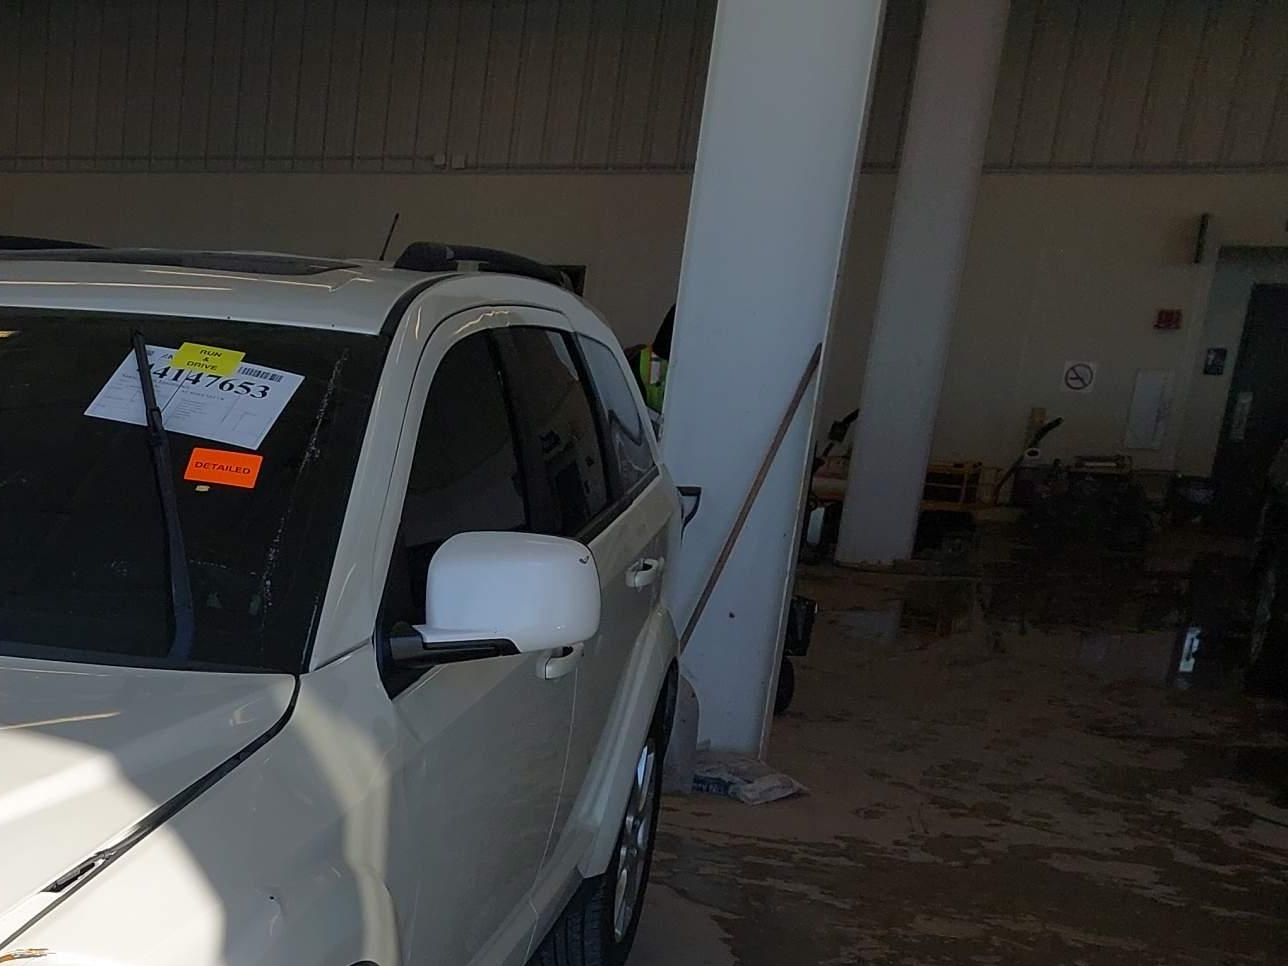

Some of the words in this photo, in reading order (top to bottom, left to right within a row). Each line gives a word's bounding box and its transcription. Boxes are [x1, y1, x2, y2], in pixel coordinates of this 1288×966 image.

[199, 349, 223, 358] RUN
[186, 360, 219, 371] DRIVE
[194, 461, 252, 475] DETAILED
